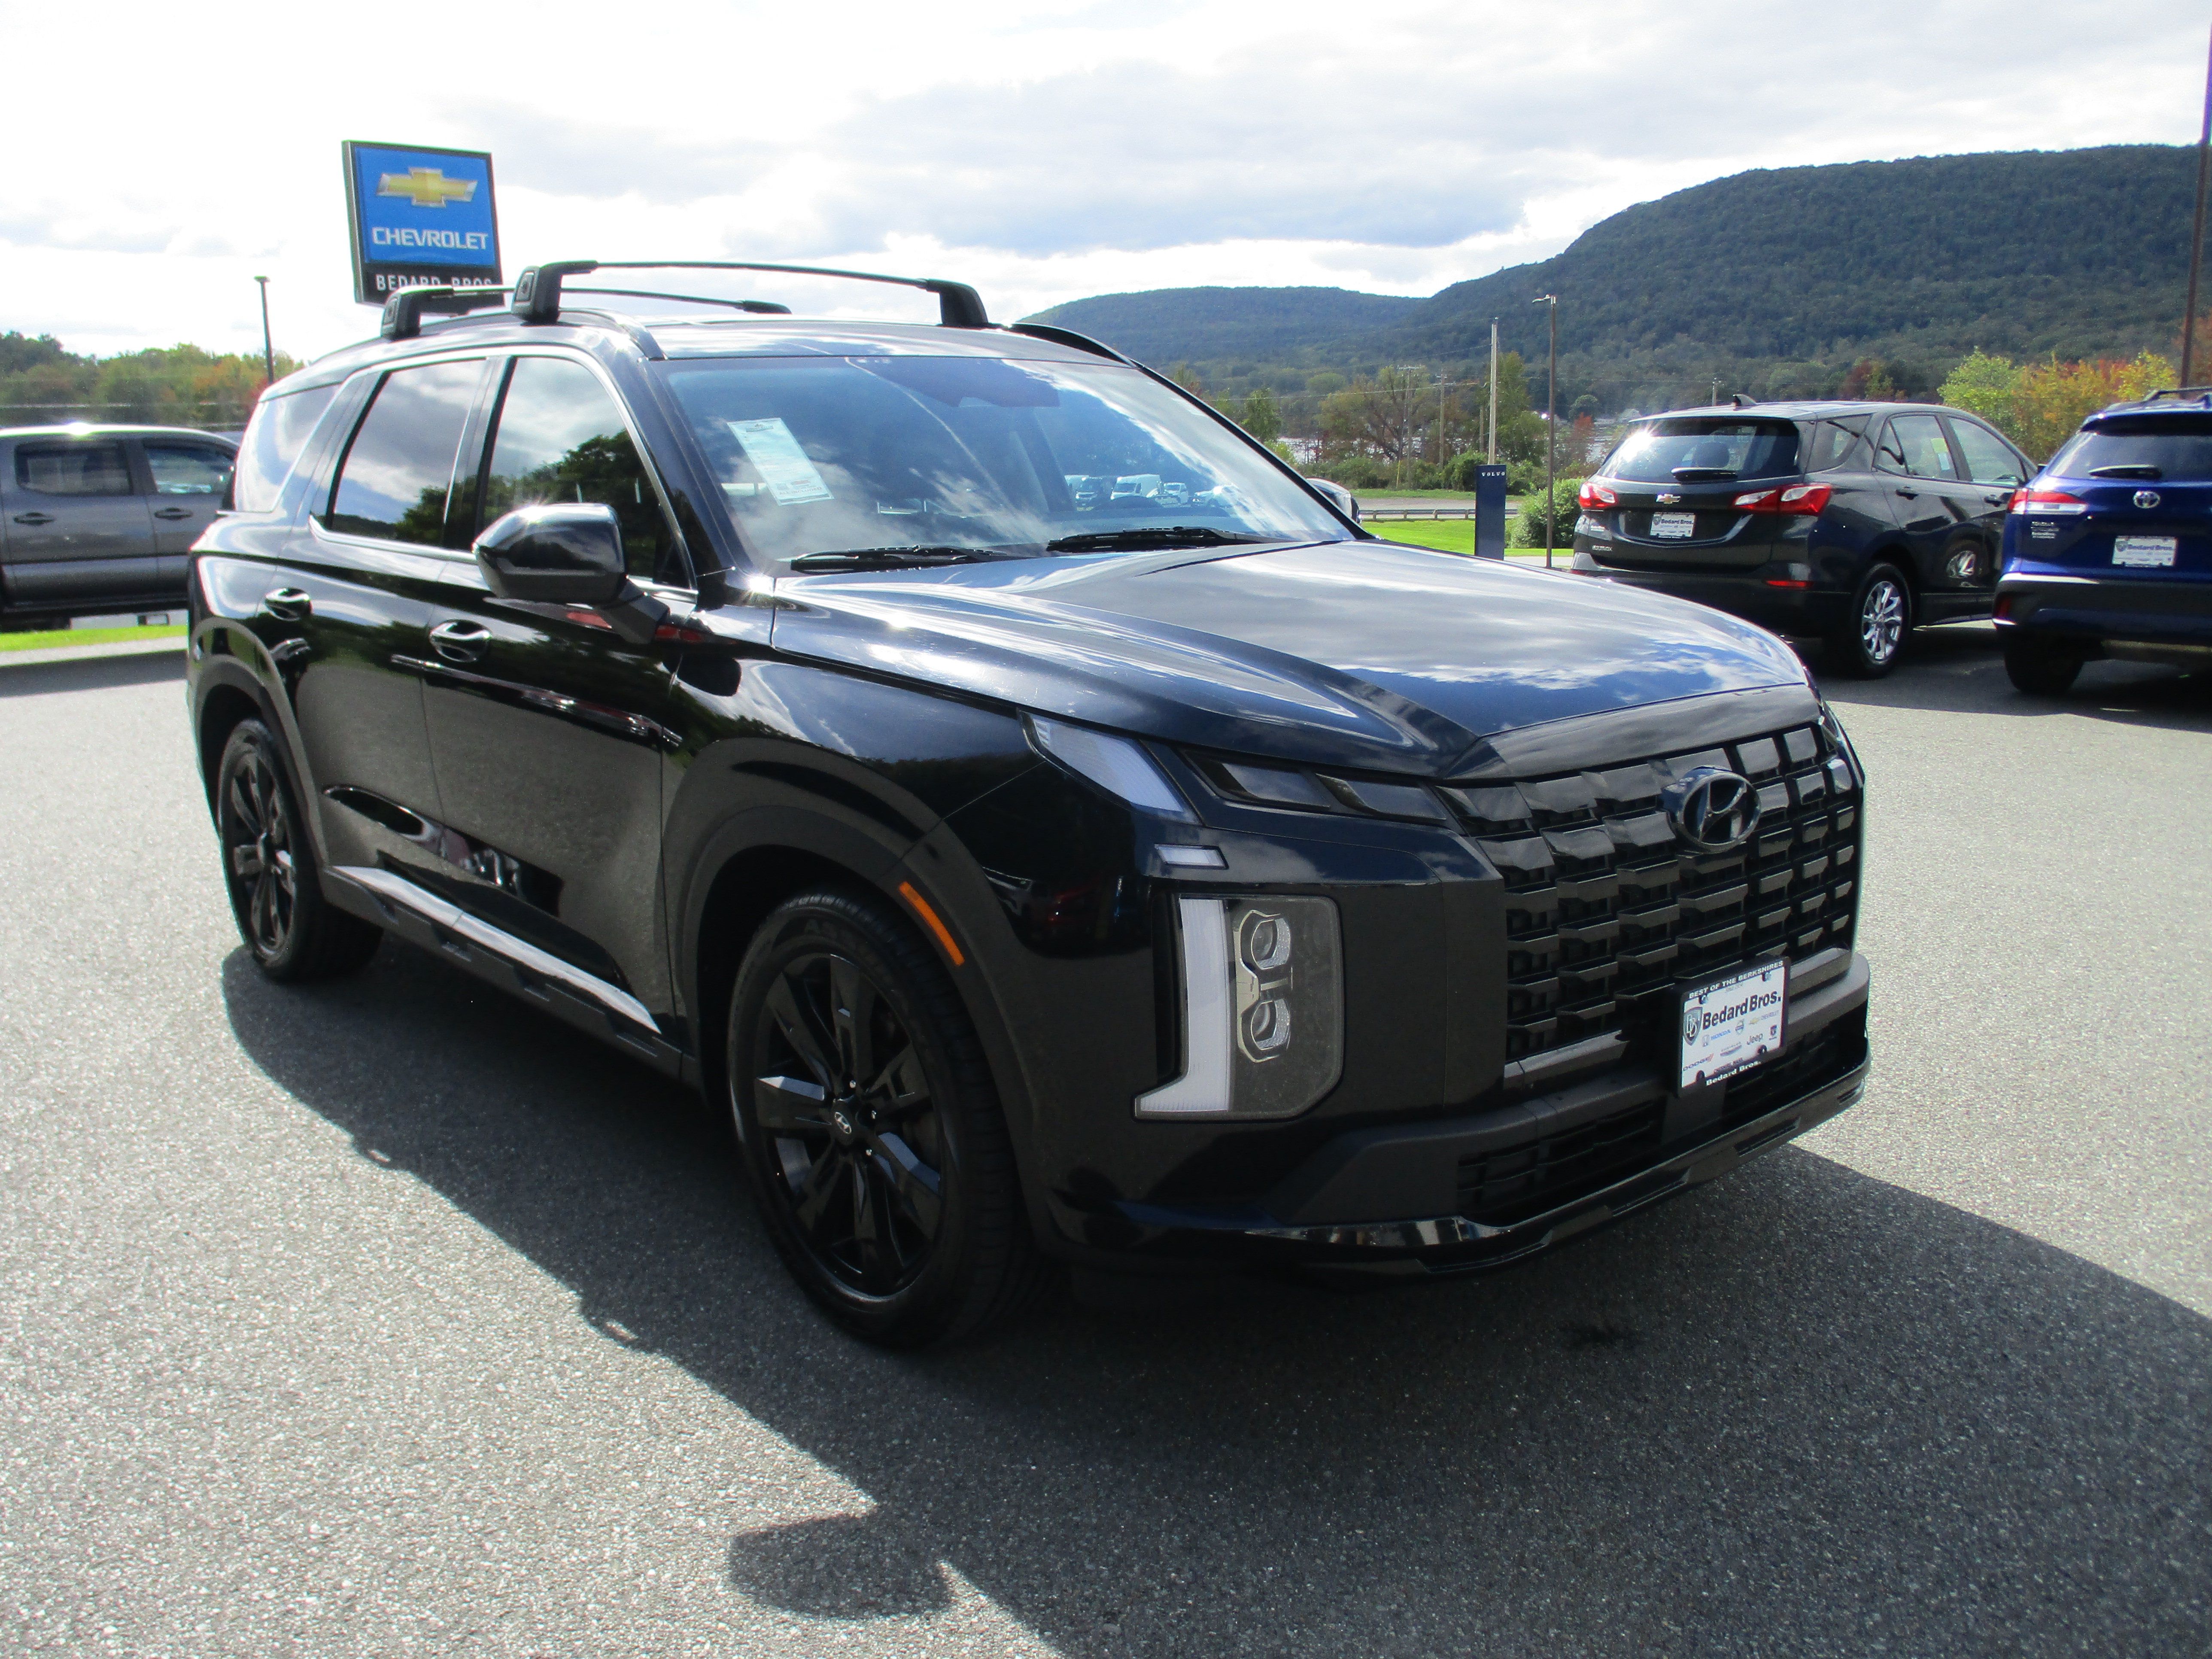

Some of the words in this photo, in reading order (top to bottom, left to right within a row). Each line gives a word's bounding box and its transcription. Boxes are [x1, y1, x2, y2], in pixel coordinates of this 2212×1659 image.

[372, 227, 488, 250] CHEVROLET
[375, 273, 440, 291] BEDARD
[1689, 987, 1709, 998] BEST
[1710, 983, 1720, 991] OF
[1722, 977, 1737, 987] THE
[1738, 960, 1784, 981] BERKSHIRES
[1702, 998, 1748, 1030] Bedard
[1749, 991, 1781, 1012] Bros.
[1747, 1033, 1763, 1045] Jeep
[1706, 1068, 1737, 1086] Bedard
